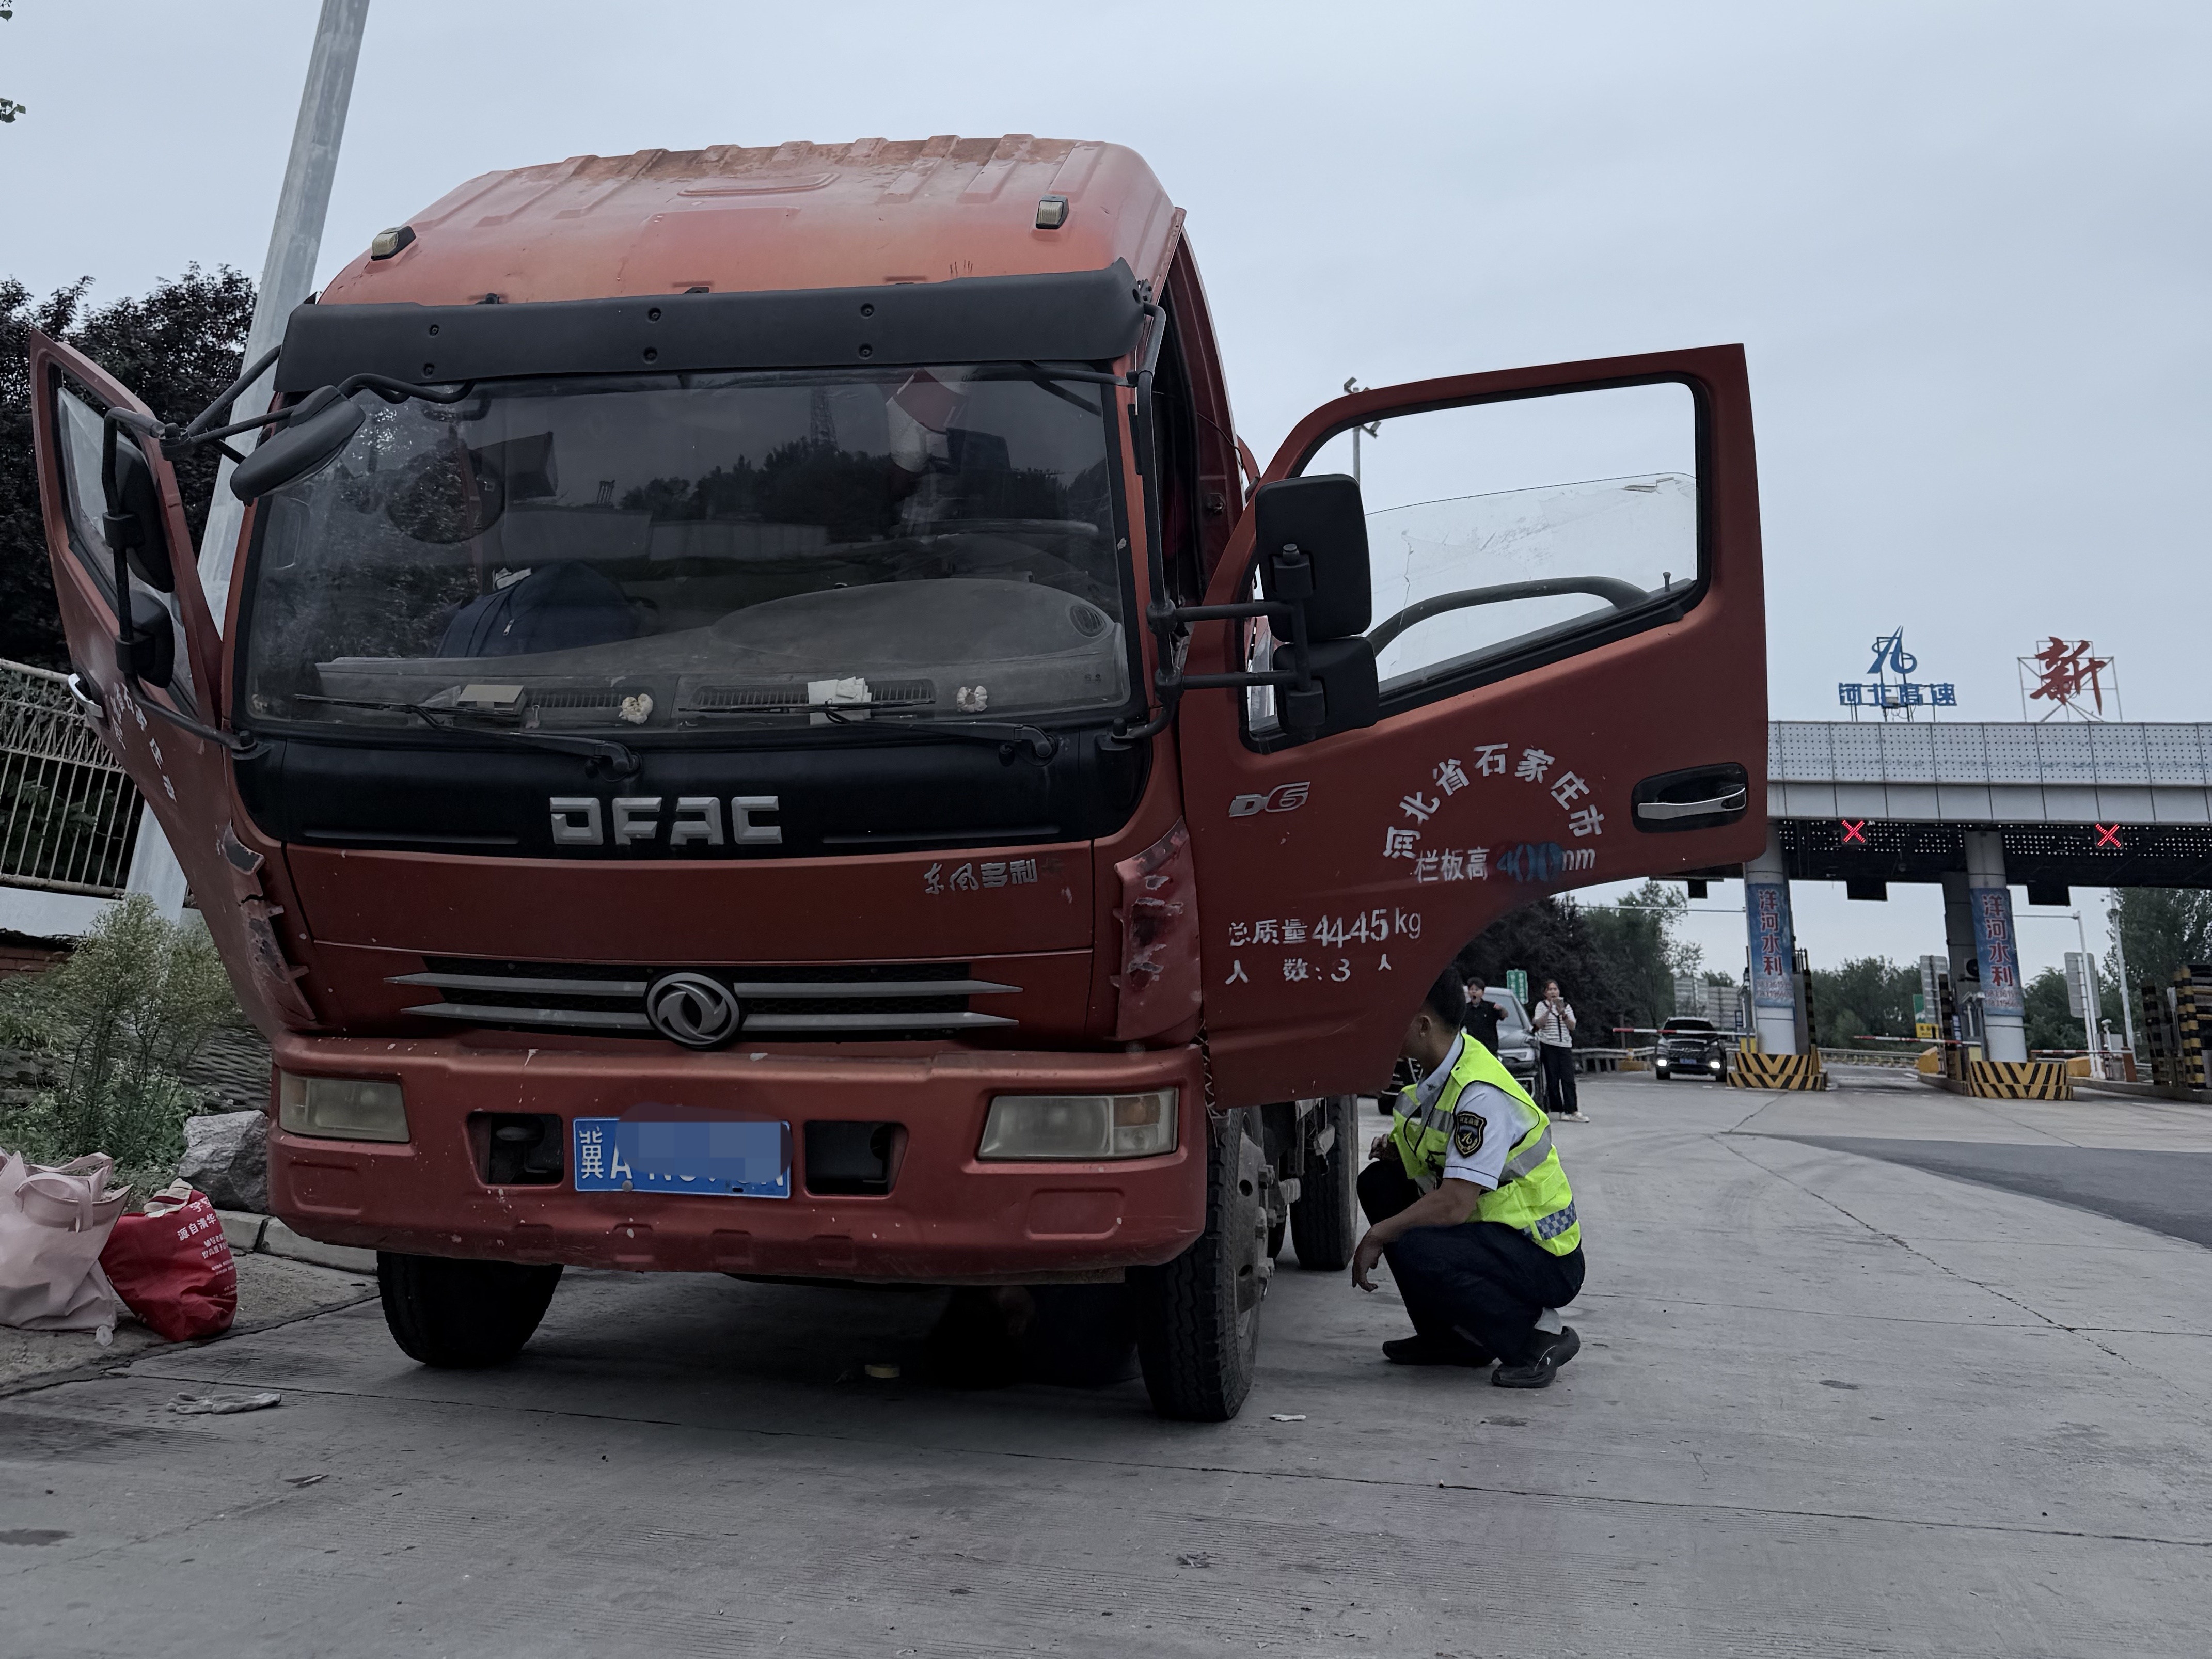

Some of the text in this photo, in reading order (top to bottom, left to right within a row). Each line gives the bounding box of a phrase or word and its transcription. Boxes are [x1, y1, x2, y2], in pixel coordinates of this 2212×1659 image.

[1839, 682, 1957, 709] 河北高速
[2030, 636, 2107, 716] 新
[550, 796, 783, 845] DFAC
[1383, 743, 1604, 859] 河北省石家庄市
[924, 858, 1038, 895] 东风多利
[1758, 889, 1784, 977] 洋河水利
[1982, 894, 2015, 987] 洋河水利
[177, 1213, 216, 1241] 源自清华
